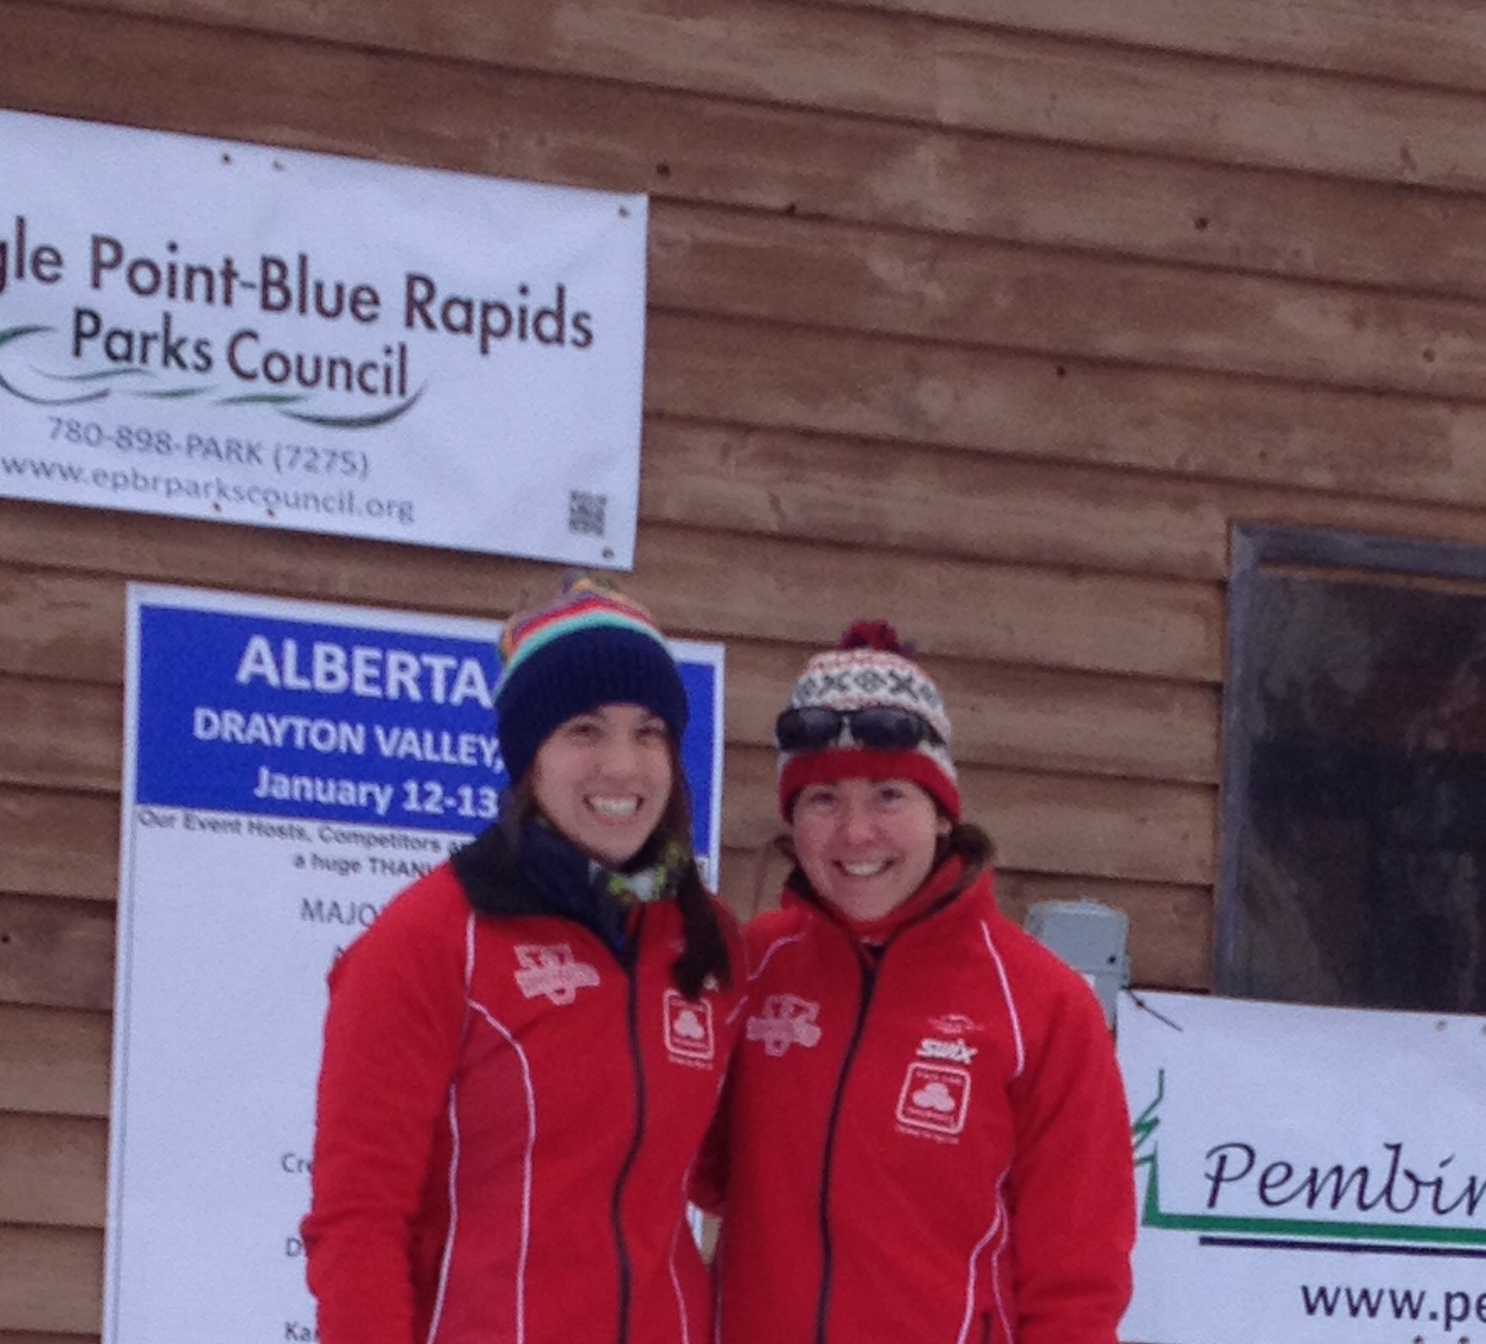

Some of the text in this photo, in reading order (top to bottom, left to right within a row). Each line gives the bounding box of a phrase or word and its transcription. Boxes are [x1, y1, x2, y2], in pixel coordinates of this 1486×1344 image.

[91, 233, 381, 324] Point-Blue
[404, 273, 595, 356] Rapids
[72, 305, 409, 397] Parks Council
[47, 416, 370, 480] 780-898-PARK (7275)
[0, 455, 415, 525] www.epbrparkscouncil.org
[236, 634, 496, 710] ALBERTA
[192, 706, 505, 775] DRAYTON VALLEY,
[254, 765, 500, 820] January 12-13
[138, 808, 176, 829] Our
[182, 812, 242, 836] Event
[317, 824, 441, 854] Competitors
[294, 853, 306, 870] a
[311, 852, 362, 876] huge
[301, 898, 382, 928] MAJO
[284, 1321, 320, 1342] Ka
